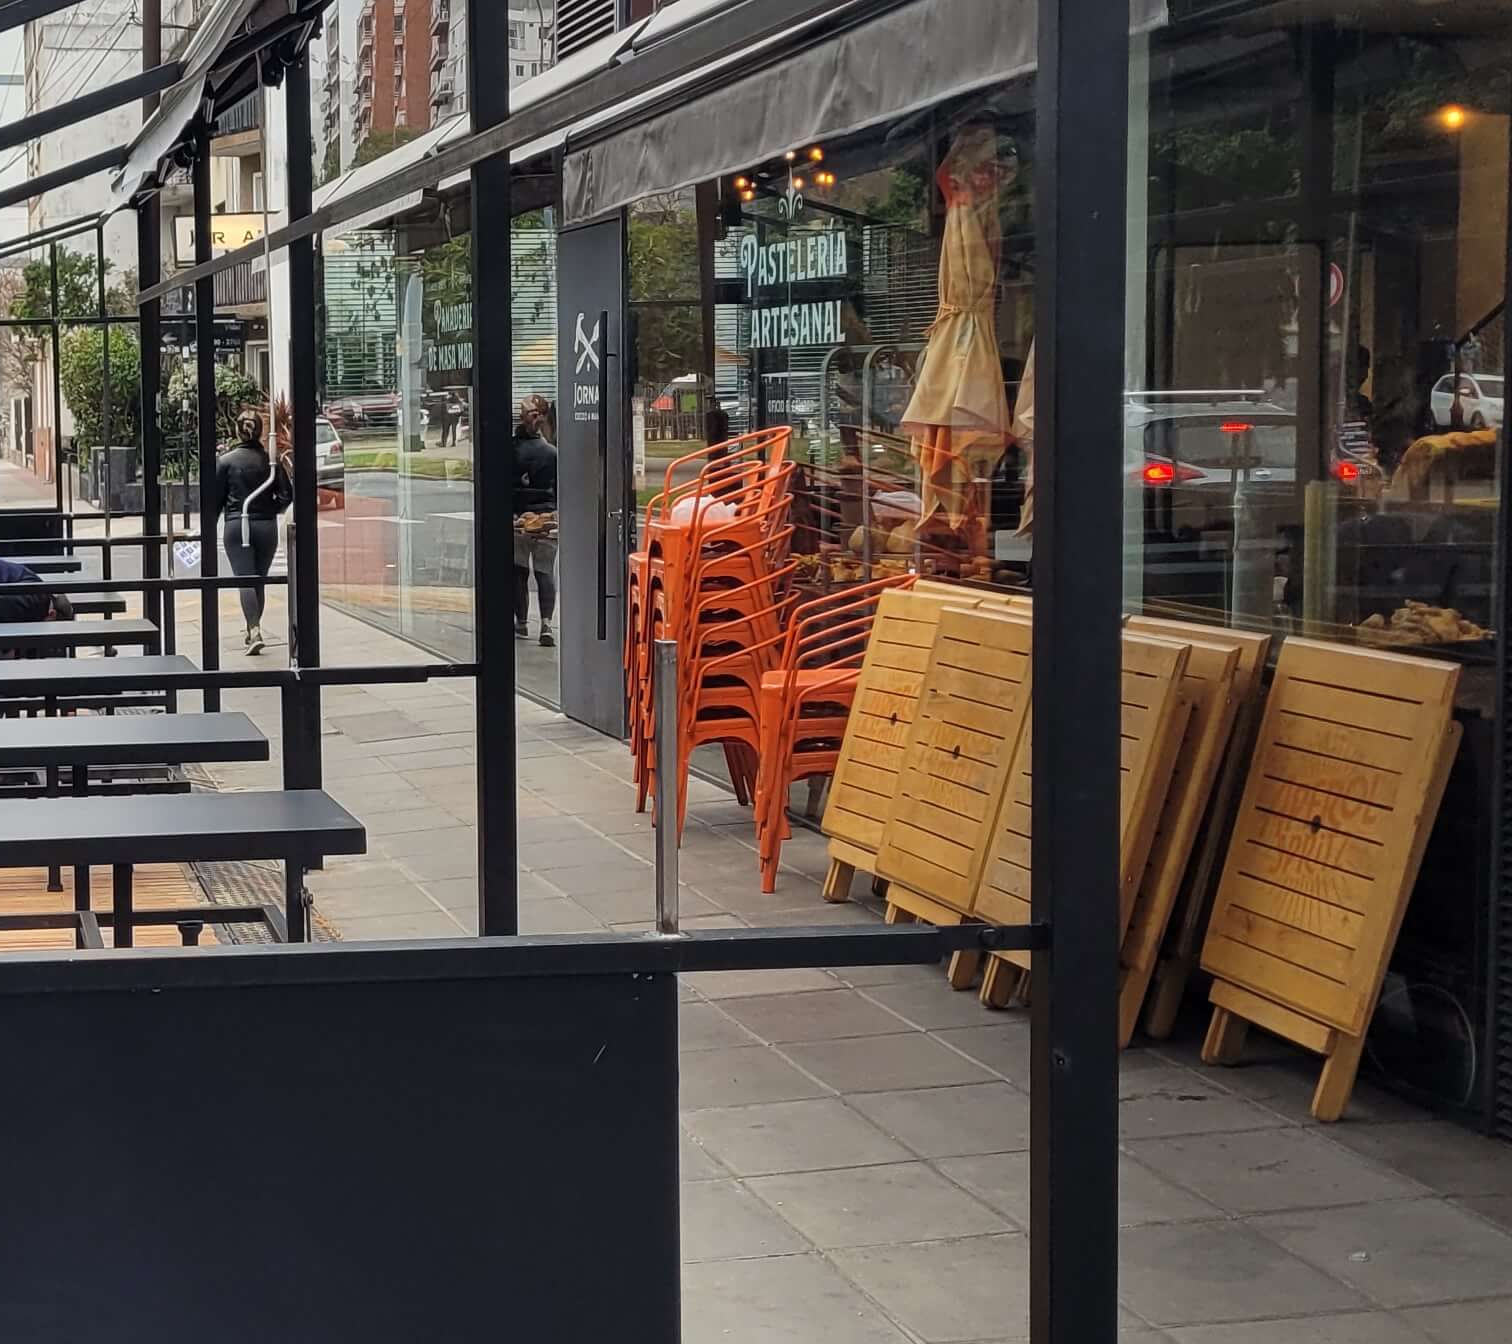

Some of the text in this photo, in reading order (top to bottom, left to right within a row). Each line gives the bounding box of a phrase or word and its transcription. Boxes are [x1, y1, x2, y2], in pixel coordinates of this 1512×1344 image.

[740, 218, 847, 297] PASTELERÍA
[750, 300, 845, 348] ARTESANAL
[428, 343, 473, 372] DE MASA MAD
[573, 382, 599, 408] JORNA
